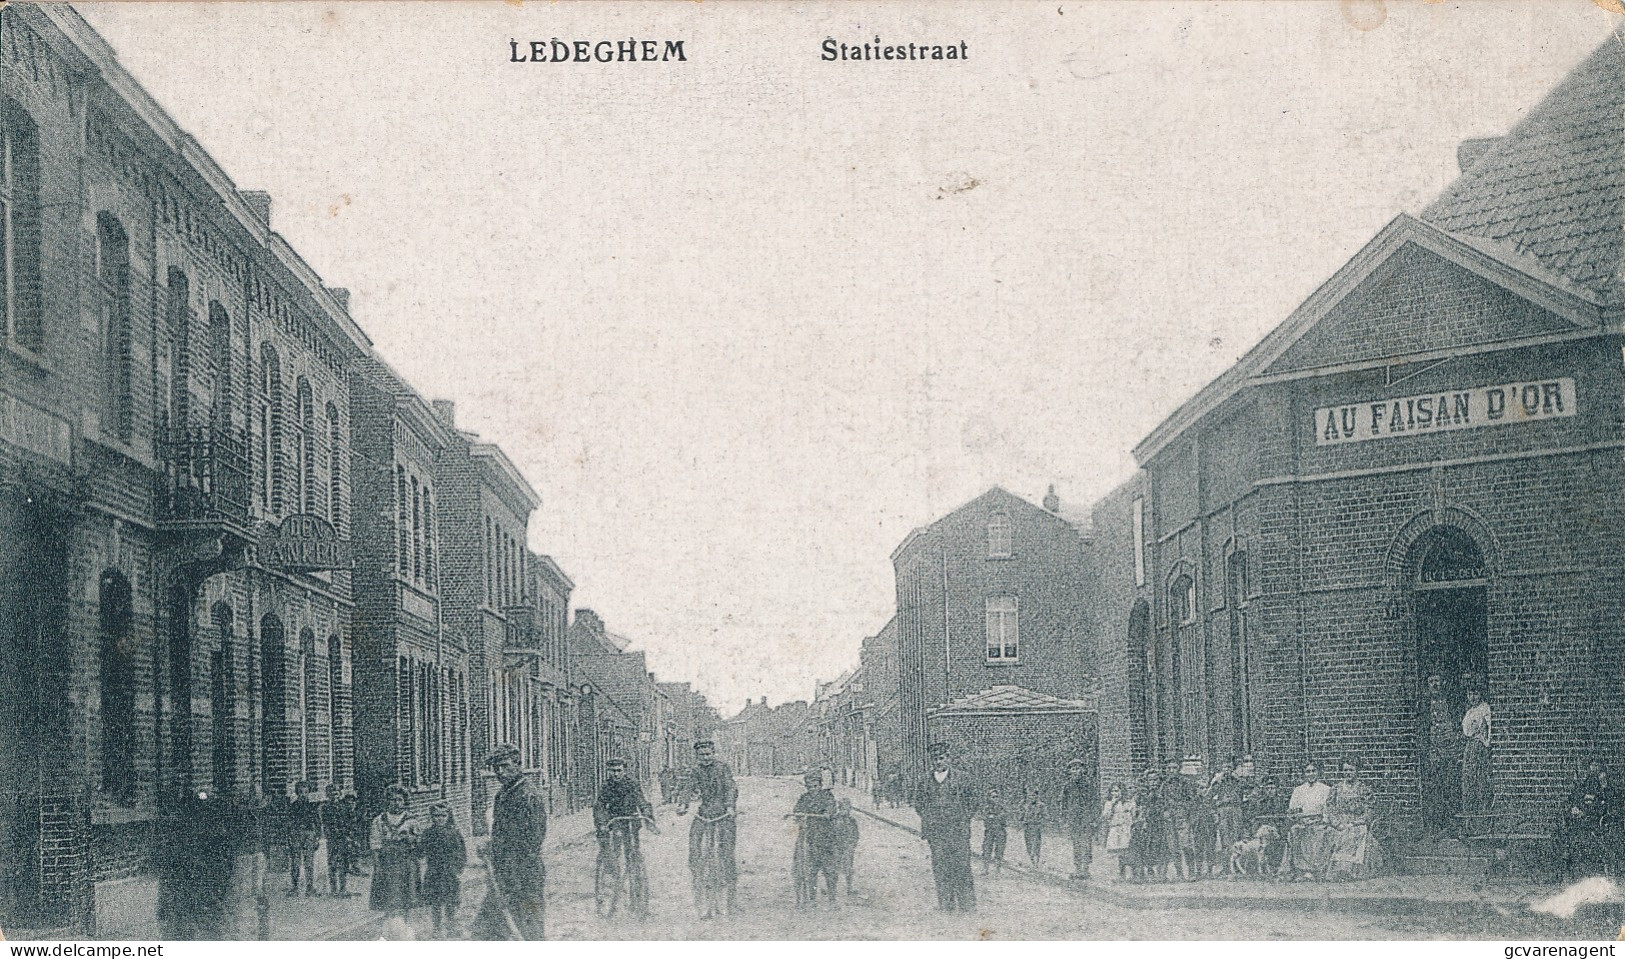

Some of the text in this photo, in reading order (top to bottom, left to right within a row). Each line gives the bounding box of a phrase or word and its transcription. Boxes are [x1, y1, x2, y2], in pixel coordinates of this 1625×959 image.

[1323, 381, 1565, 440] AU FAISAN D'OR
